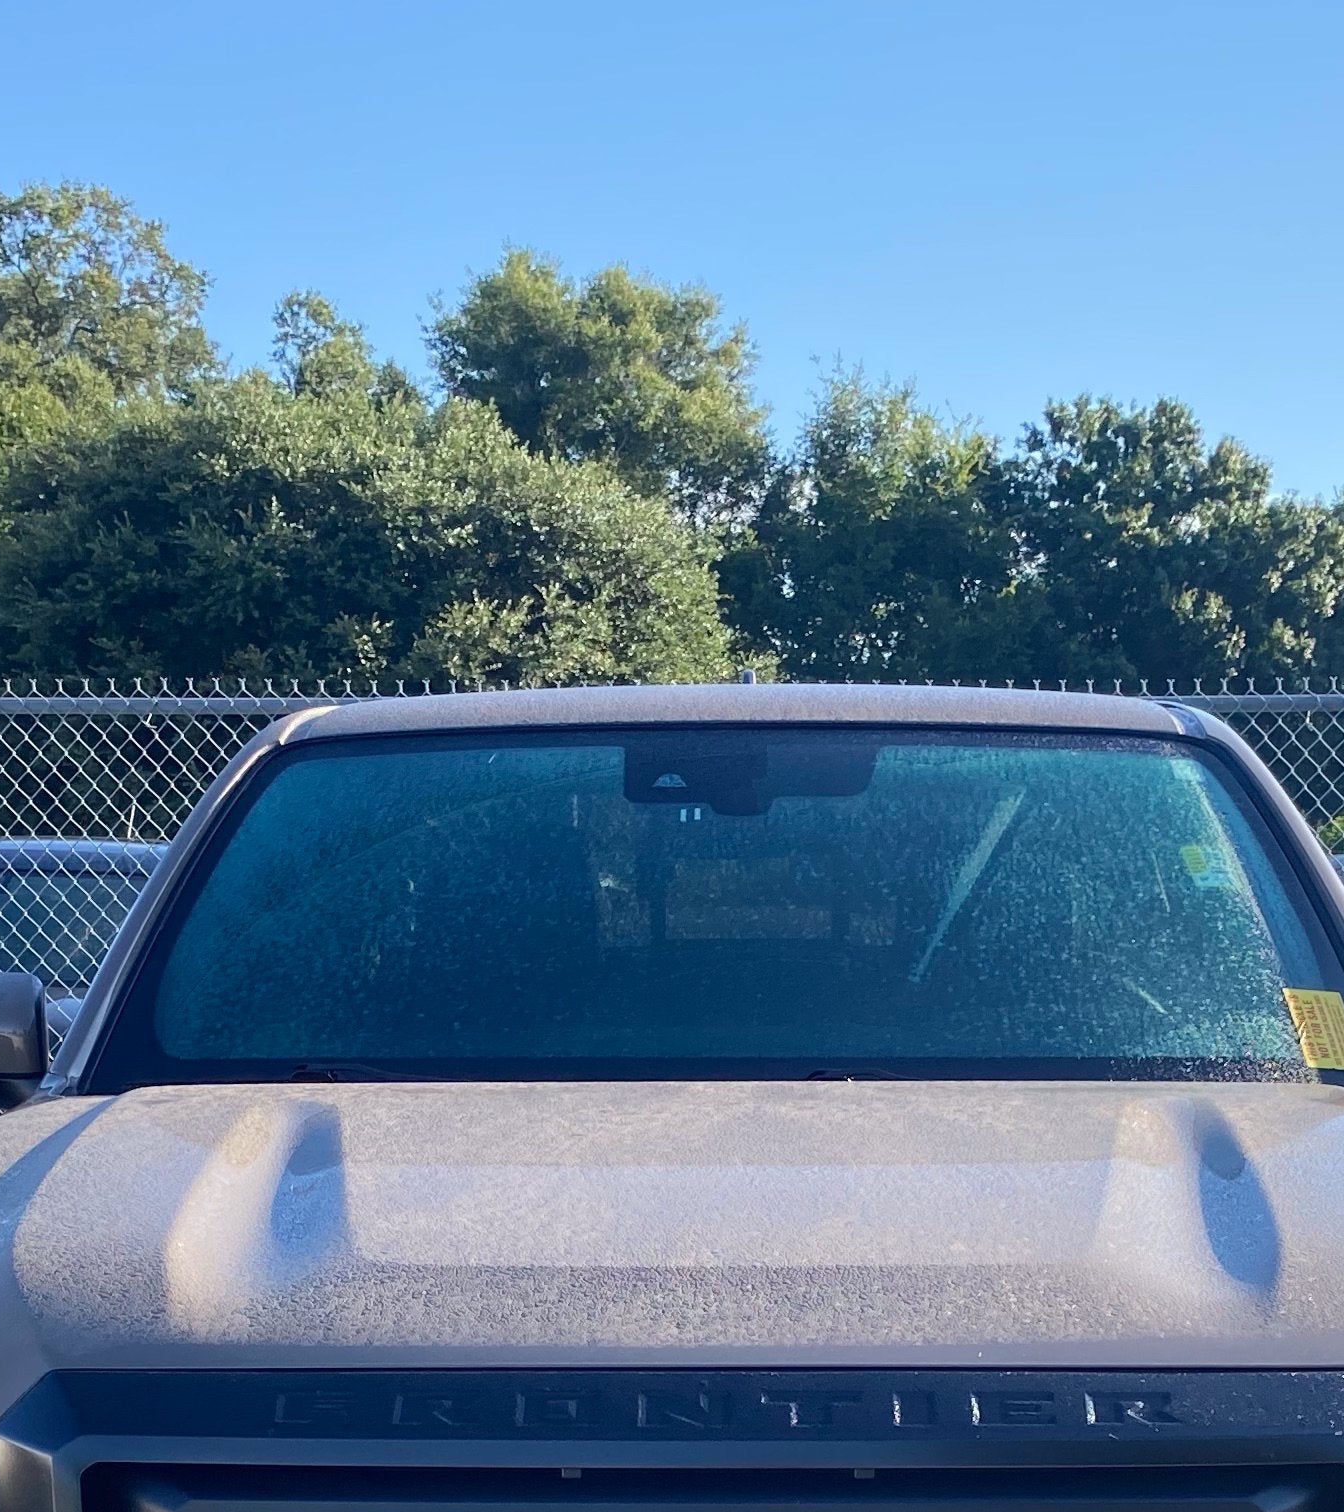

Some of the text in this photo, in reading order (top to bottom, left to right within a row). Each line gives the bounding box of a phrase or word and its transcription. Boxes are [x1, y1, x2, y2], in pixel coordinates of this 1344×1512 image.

[1303, 1000, 1331, 1058] NOT FOR SALE
[273, 1391, 1184, 1428] FRONTIER
